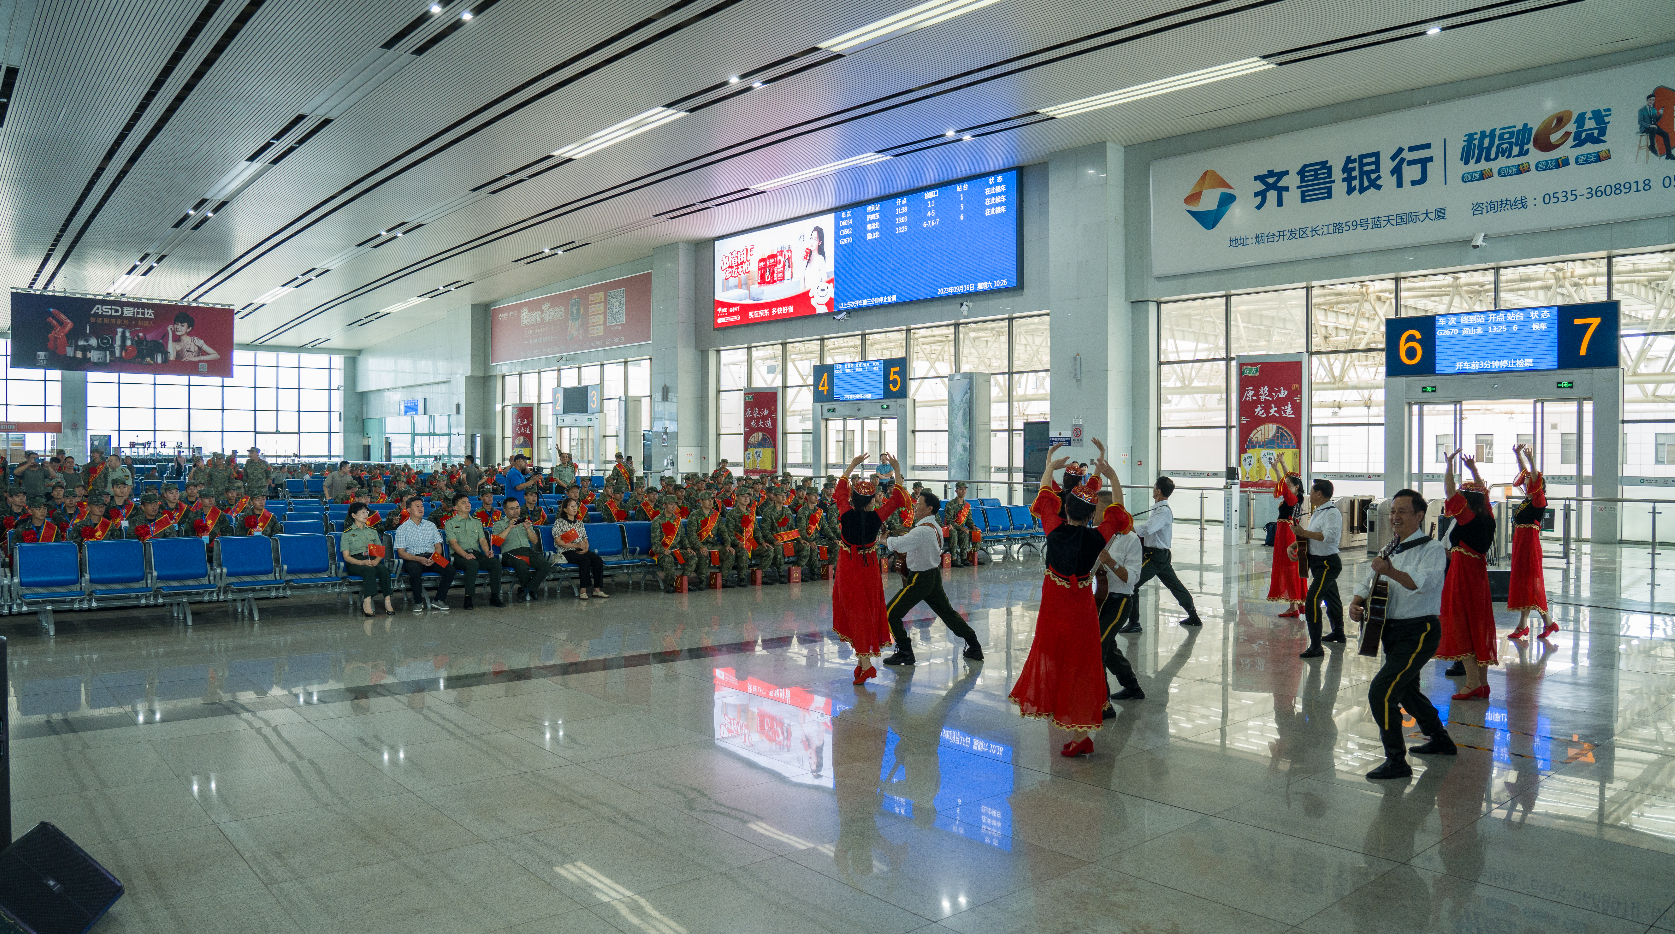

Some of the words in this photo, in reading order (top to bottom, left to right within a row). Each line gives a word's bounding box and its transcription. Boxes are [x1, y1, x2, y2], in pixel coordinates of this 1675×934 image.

[1460, 108, 1612, 166] 税融e贷
[1252, 142, 1434, 210] 齐鲁银行
[90, 304, 122, 315] ASD
[123, 306, 155, 318] 爱仕达
[1438, 317, 1456, 325] 车次
[1488, 314, 1505, 322] 开点
[1507, 312, 1524, 321] 站台
[1530, 310, 1550, 319] 状态
[1436, 328, 1458, 336] G2670
[1574, 317, 1602, 356] 7
[1399, 330, 1422, 365] 6
[1455, 358, 1534, 370] 开车前3分钟停止检票
[818, 373, 828, 395] 4
[889, 367, 900, 392] 5
[555, 394, 561, 409] 2
[590, 391, 597, 408] 3
[1242, 386, 1288, 402] 原浆油
